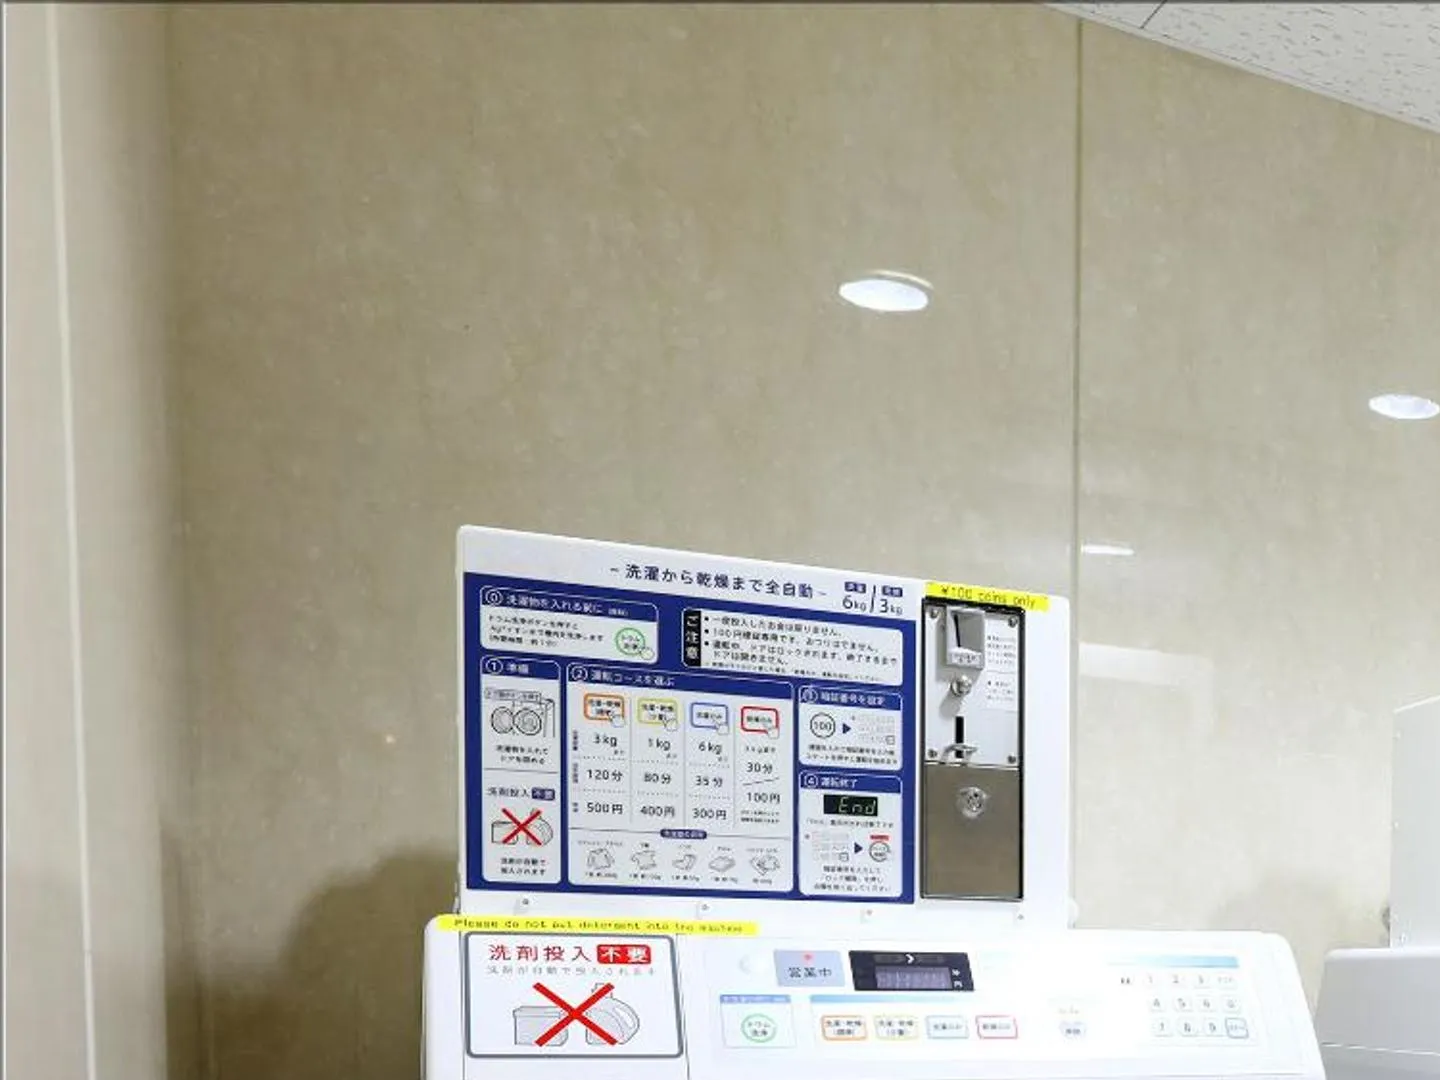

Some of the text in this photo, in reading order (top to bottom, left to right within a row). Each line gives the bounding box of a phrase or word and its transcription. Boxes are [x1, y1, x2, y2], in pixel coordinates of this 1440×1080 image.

[625, 563, 813, 599] 洗濯から乾燥まで全自動
[587, 768, 623, 782] 120分
[587, 801, 623, 815] 500円
[454, 918, 498, 928] Please
[504, 920, 520, 929] do
[524, 920, 547, 929] not
[488, 944, 592, 962] 洗剤投入
